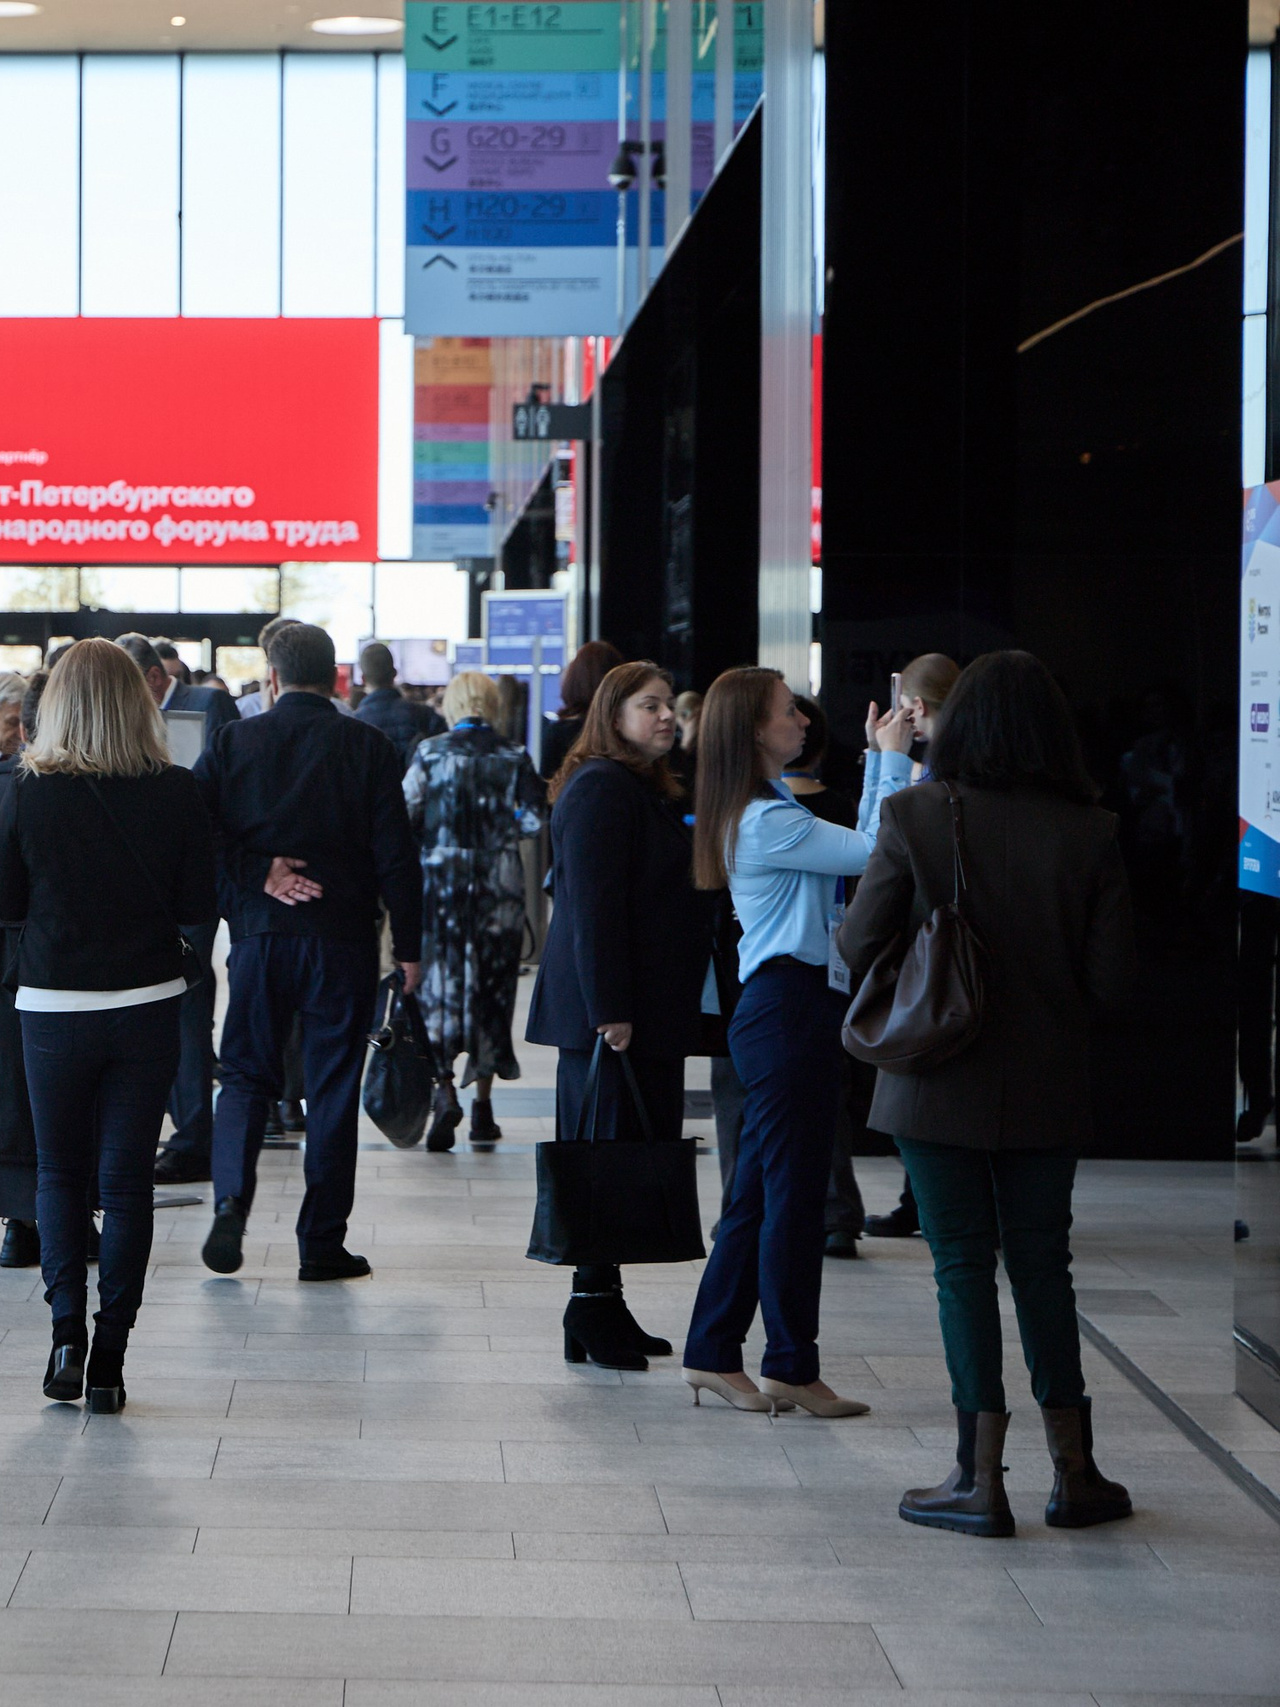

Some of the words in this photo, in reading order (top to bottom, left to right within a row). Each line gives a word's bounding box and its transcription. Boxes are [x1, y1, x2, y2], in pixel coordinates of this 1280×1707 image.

[432, 6, 449, 33] E
[467, 5, 561, 27] E1-E12
[433, 73, 449, 98] F
[430, 127, 450, 154] G
[467, 126, 566, 149] G20-29
[429, 197, 450, 222] H
[465, 195, 567, 218] H20-29
[153, 514, 270, 547] форума
[271, 519, 360, 547] труда
